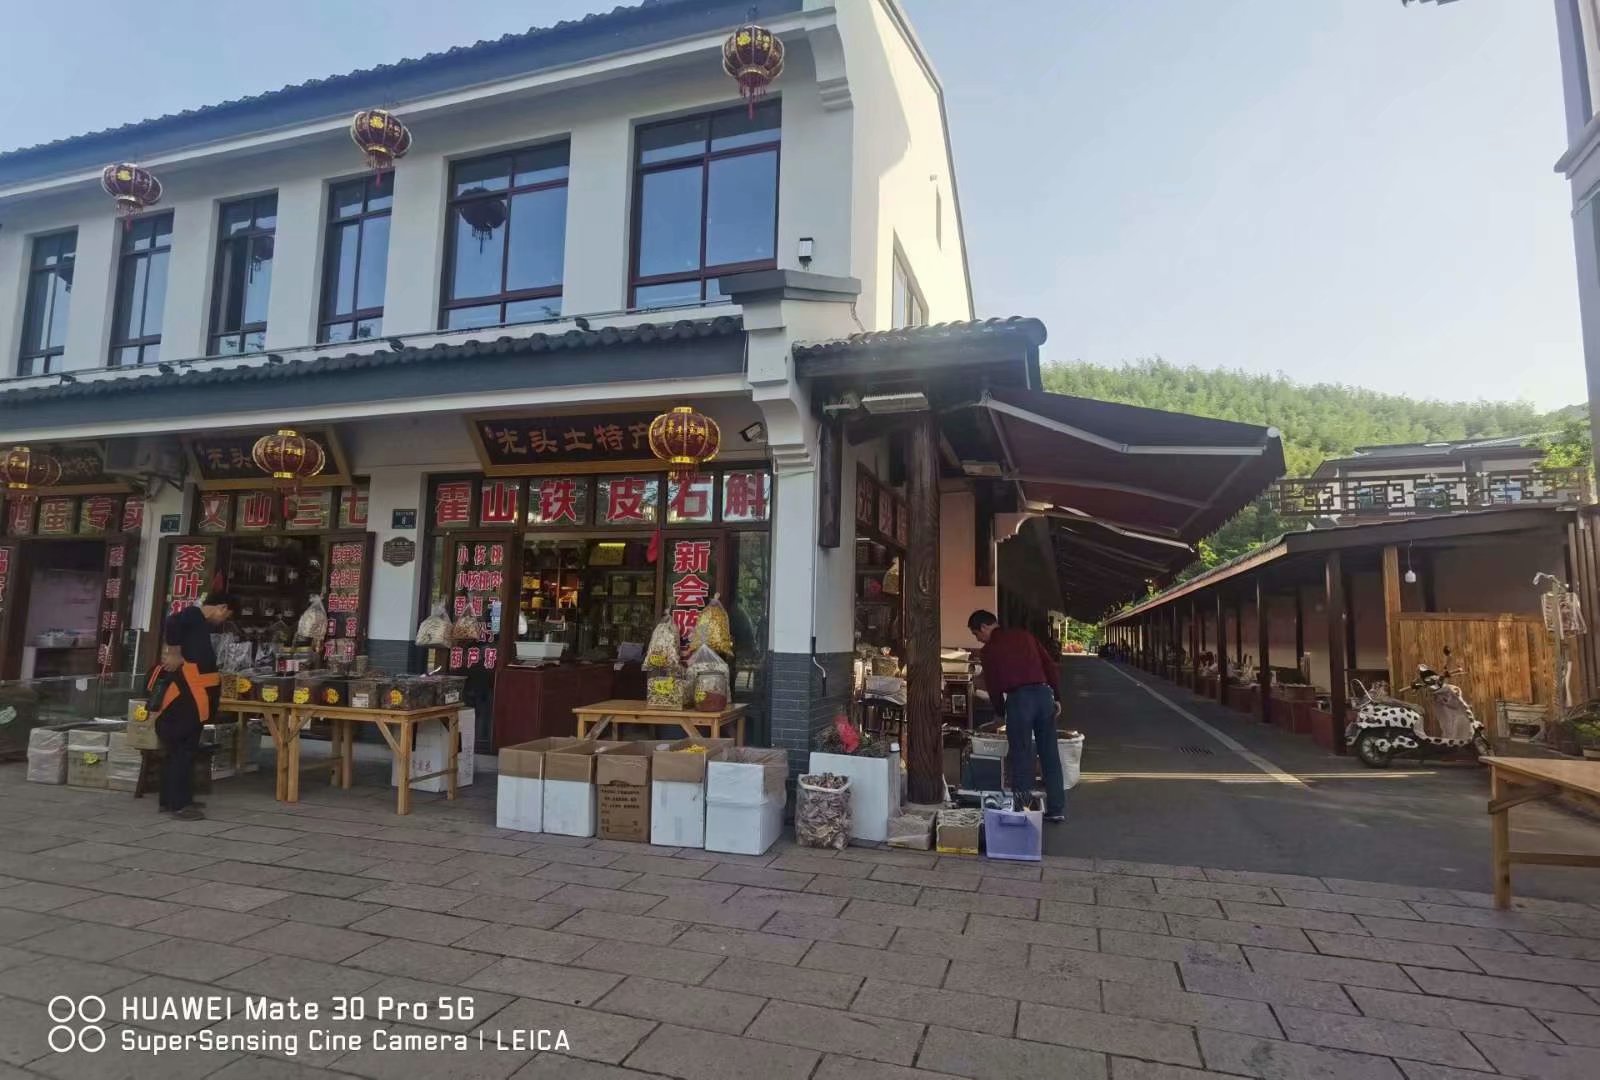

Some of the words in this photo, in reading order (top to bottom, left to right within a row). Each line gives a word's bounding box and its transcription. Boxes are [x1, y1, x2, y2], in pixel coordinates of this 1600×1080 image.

[199, 490, 369, 529] 文山三七
[435, 470, 770, 526] 霍山铁皮石斛
